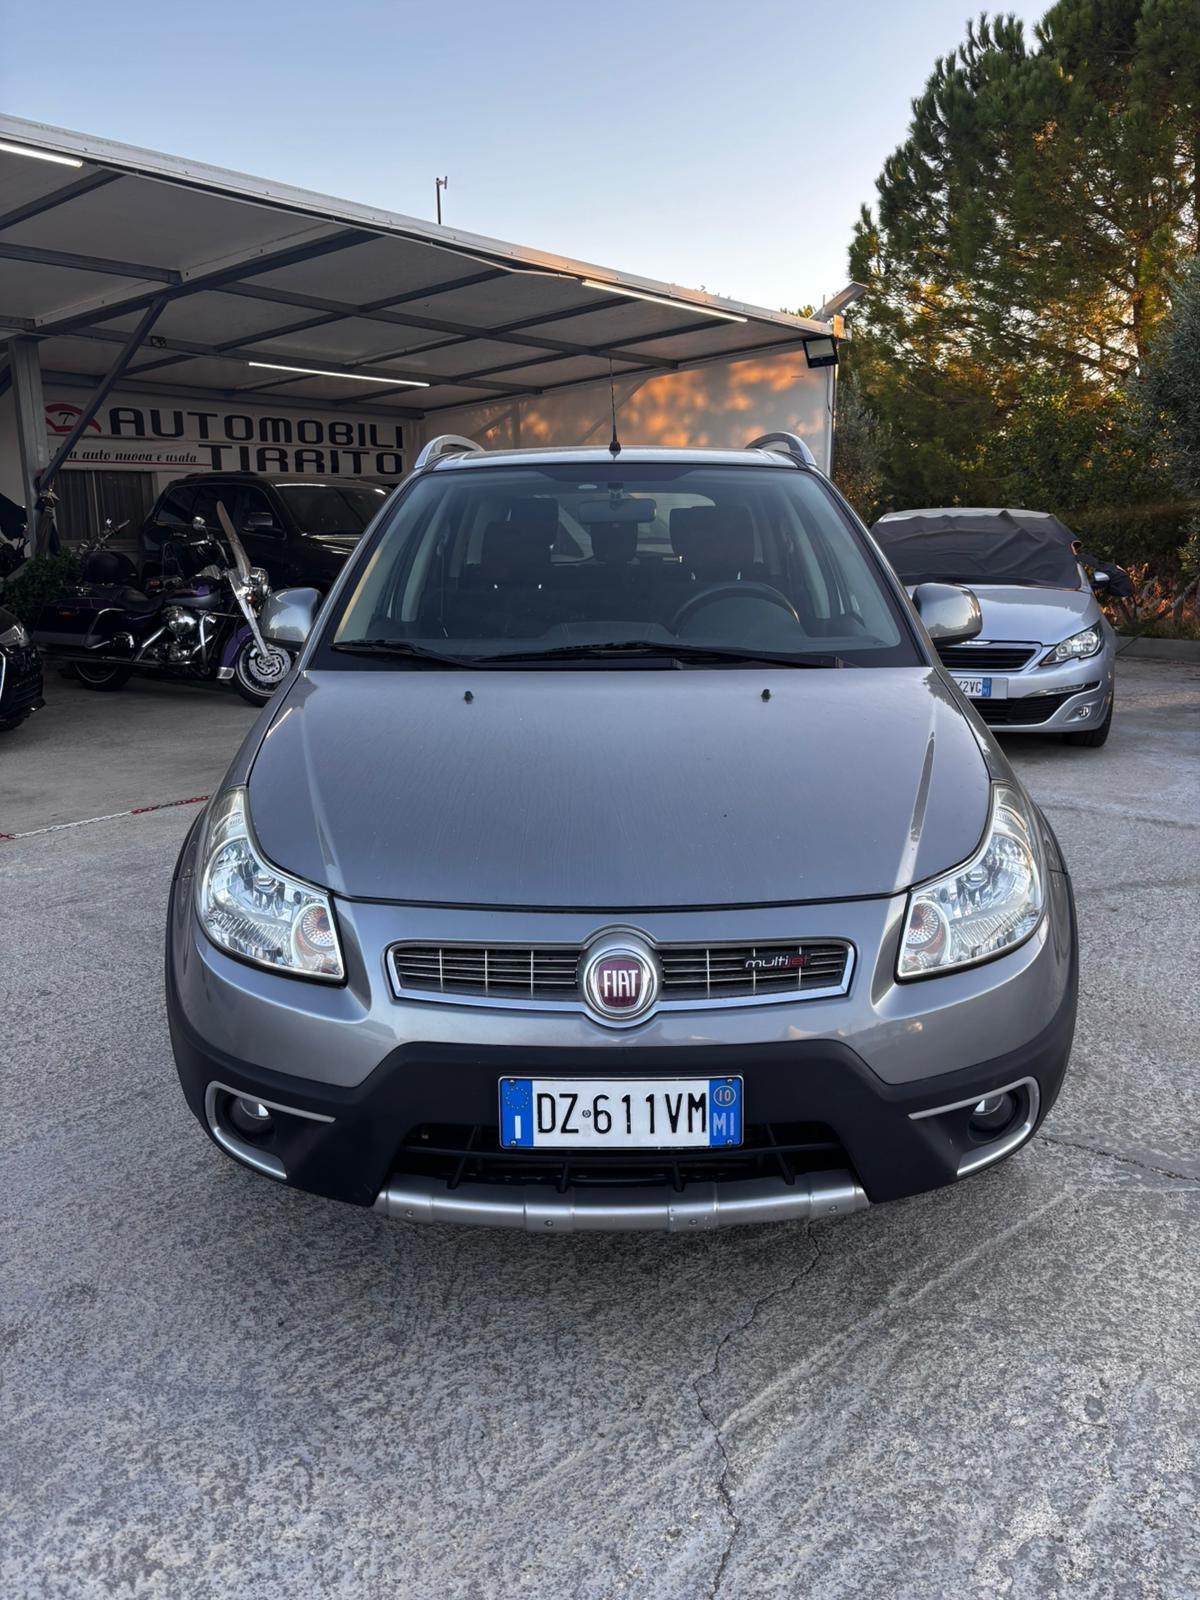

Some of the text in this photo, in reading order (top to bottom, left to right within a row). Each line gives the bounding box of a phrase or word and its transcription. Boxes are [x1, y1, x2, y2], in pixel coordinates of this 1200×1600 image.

[109, 407, 403, 449] AUTOMOBILI
[82, 449, 111, 460] auto
[115, 452, 153, 461] nuova
[166, 452, 197, 463] usata
[198, 444, 402, 475] TIRRITO
[745, 954, 810, 971] multijet
[603, 969, 639, 998] FIAT
[713, 1113, 735, 1137] MI
